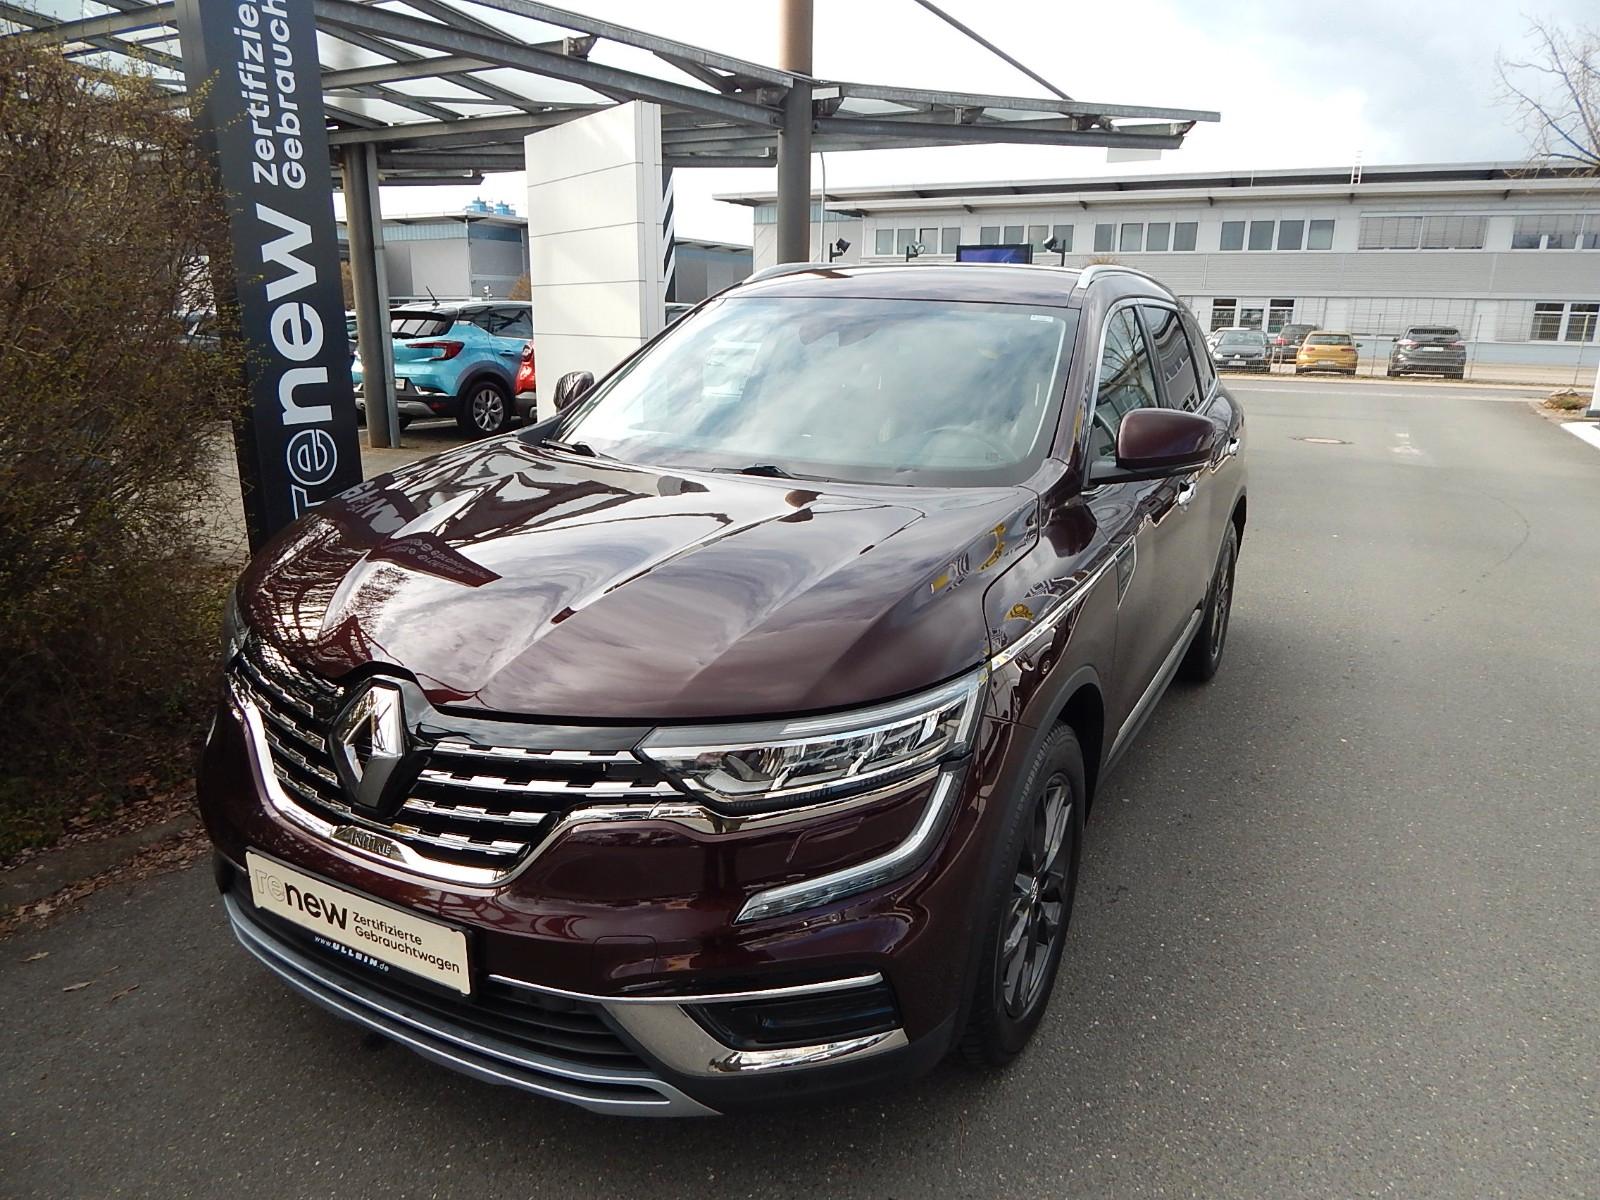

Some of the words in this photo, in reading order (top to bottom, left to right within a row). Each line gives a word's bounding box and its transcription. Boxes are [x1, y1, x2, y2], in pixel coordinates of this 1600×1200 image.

[233, 0, 279, 186] Zertifizie
[255, 869, 347, 930] renew
[353, 911, 422, 946] Zertifizierte
[354, 926, 460, 974] Gebrauchtwagen
